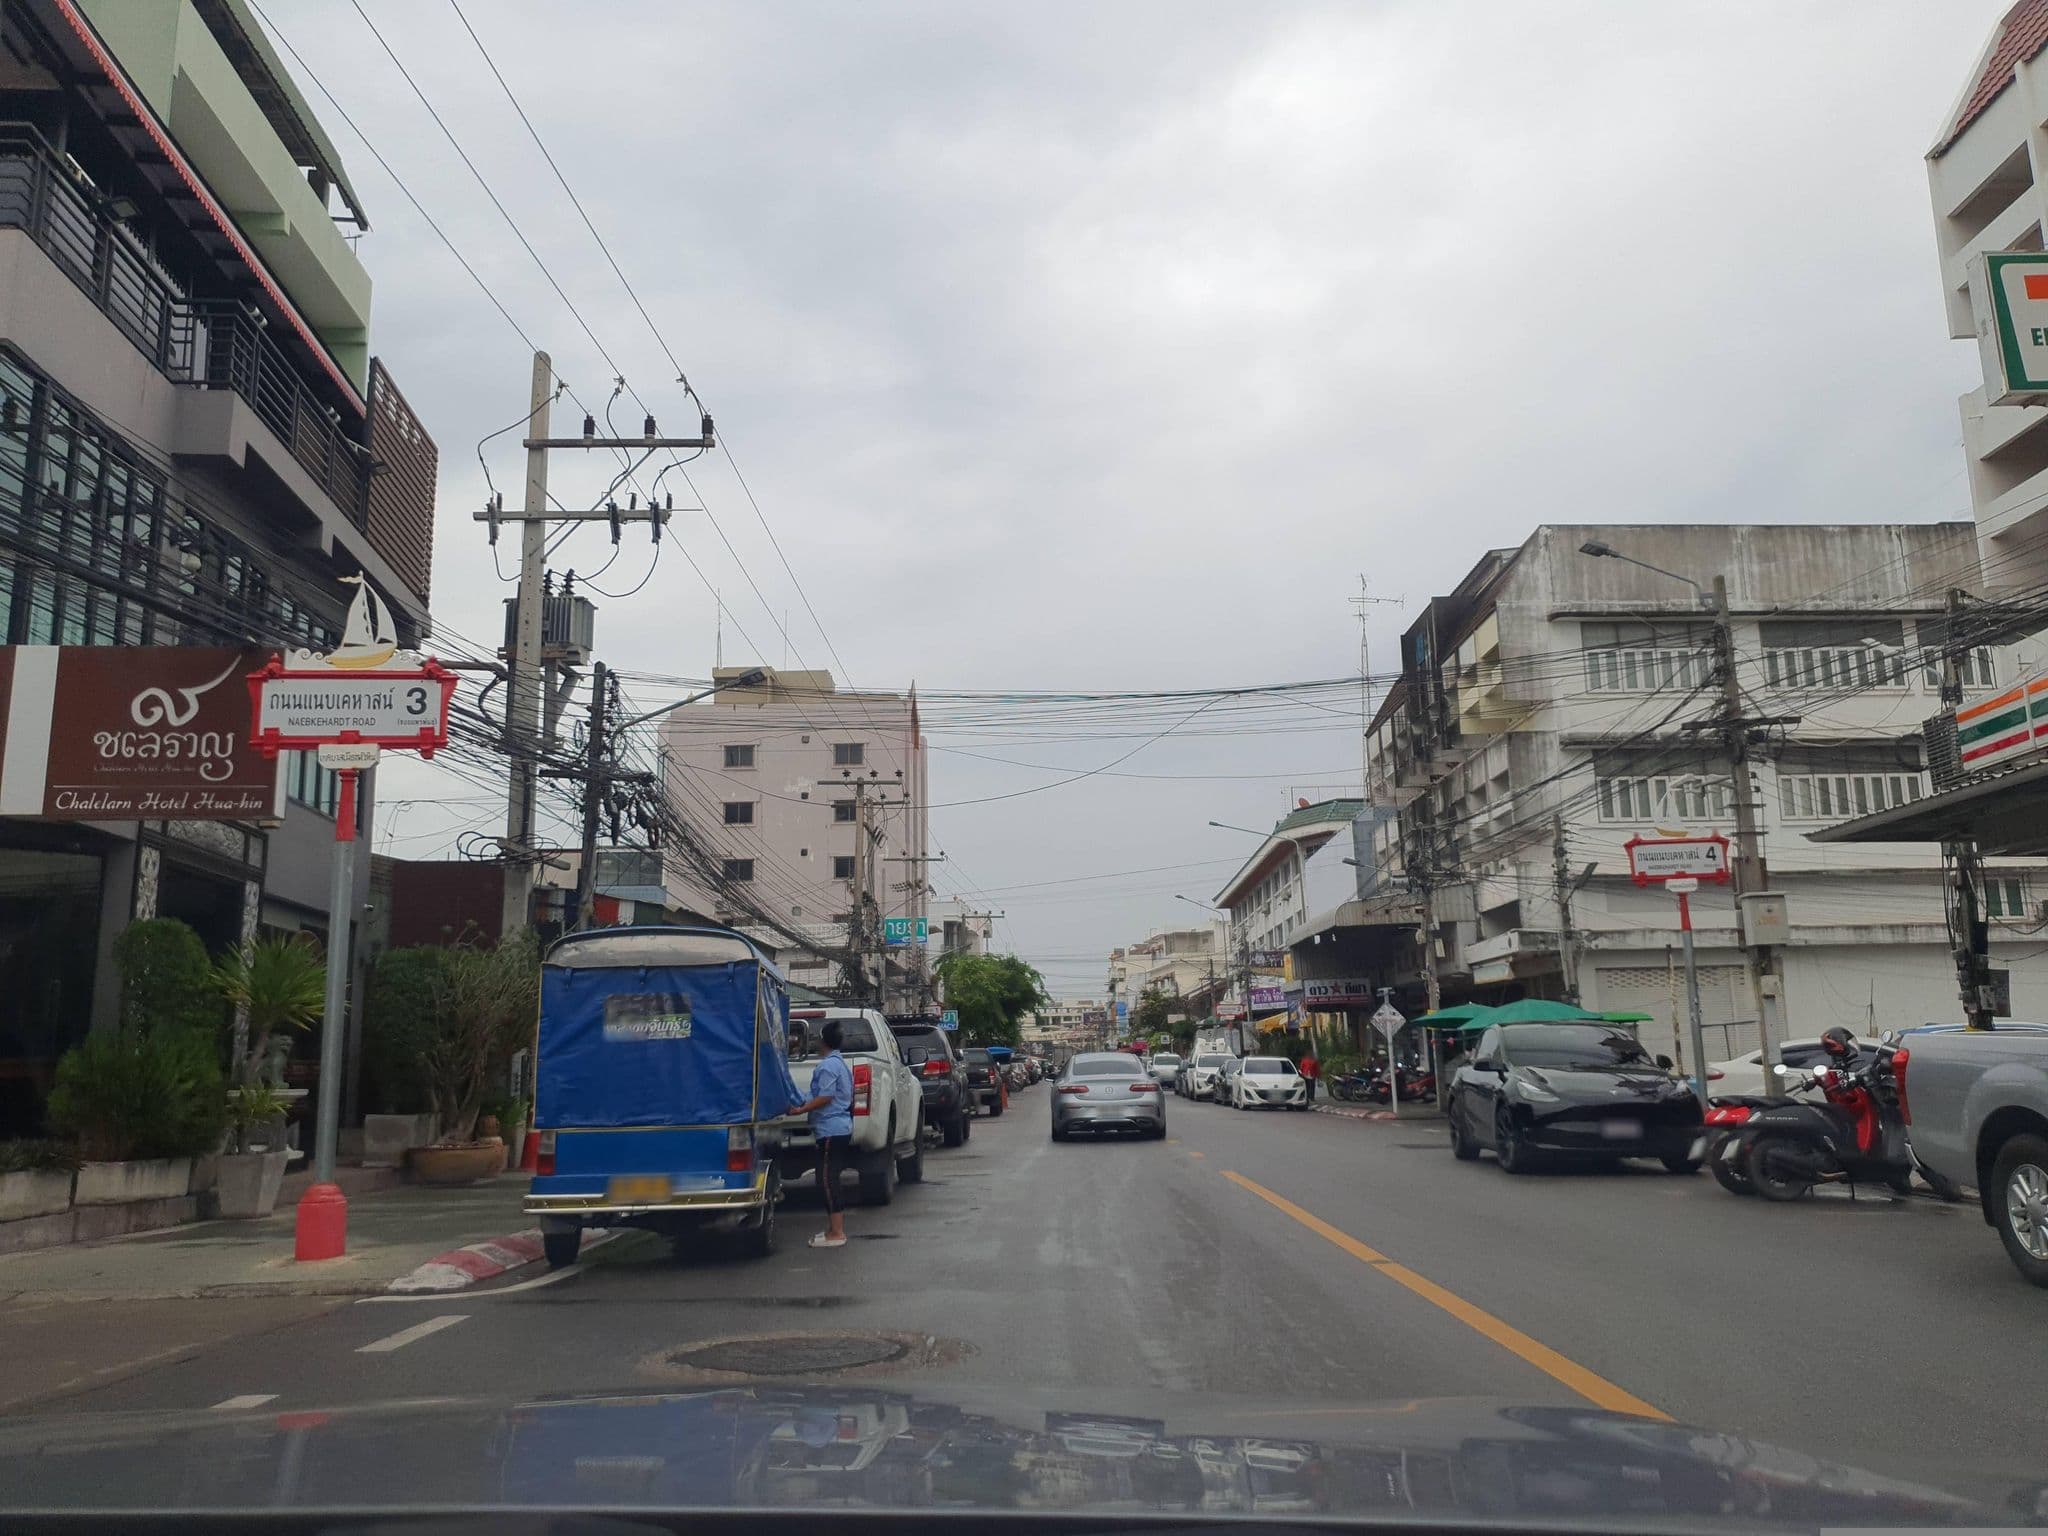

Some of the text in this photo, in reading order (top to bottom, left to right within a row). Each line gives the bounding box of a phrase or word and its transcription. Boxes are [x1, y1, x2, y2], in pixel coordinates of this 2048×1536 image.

[270, 687, 427, 715] ถนนแนบเคหาสน์ 3
[288, 717, 376, 727] NAEBKEHARDT ROAD
[55, 791, 263, 811] Chalelarn Hotel Hua-hin
[1705, 846, 1717, 861] 4
